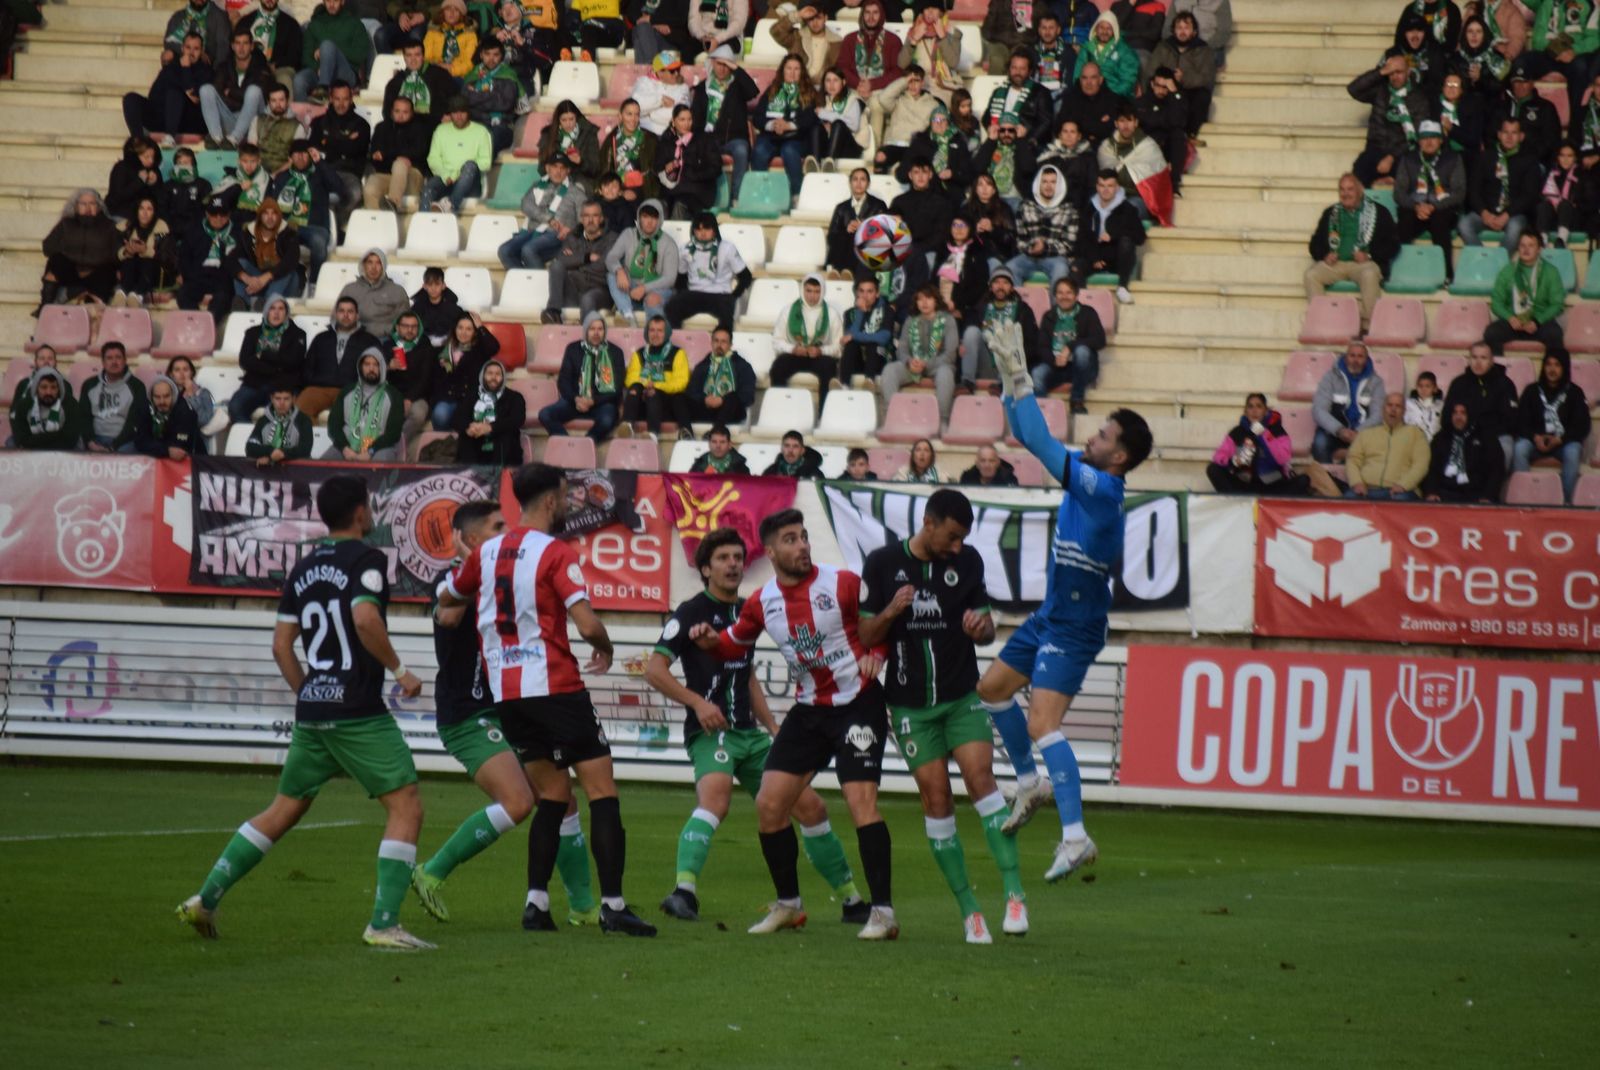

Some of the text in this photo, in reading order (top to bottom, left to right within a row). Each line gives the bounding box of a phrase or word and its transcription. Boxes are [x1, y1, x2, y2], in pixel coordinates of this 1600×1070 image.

[48, 460, 142, 480] JAMONES
[394, 477, 445, 528] RACING
[577, 532, 662, 572] es
[1408, 526, 1600, 554] ORTO
[293, 564, 349, 597] ALDASORO
[593, 583, 613, 598] 63
[617, 584, 636, 599] 01
[1402, 555, 1600, 610] tres c
[301, 598, 352, 671] 21
[1401, 616, 1457, 632] Zamora
[1470, 619, 1502, 634] 980
[1506, 621, 1527, 636] 52
[1532, 623, 1554, 637] 53
[1558, 624, 1579, 638] 55
[1177, 660, 1600, 803] COPA DEL RE
